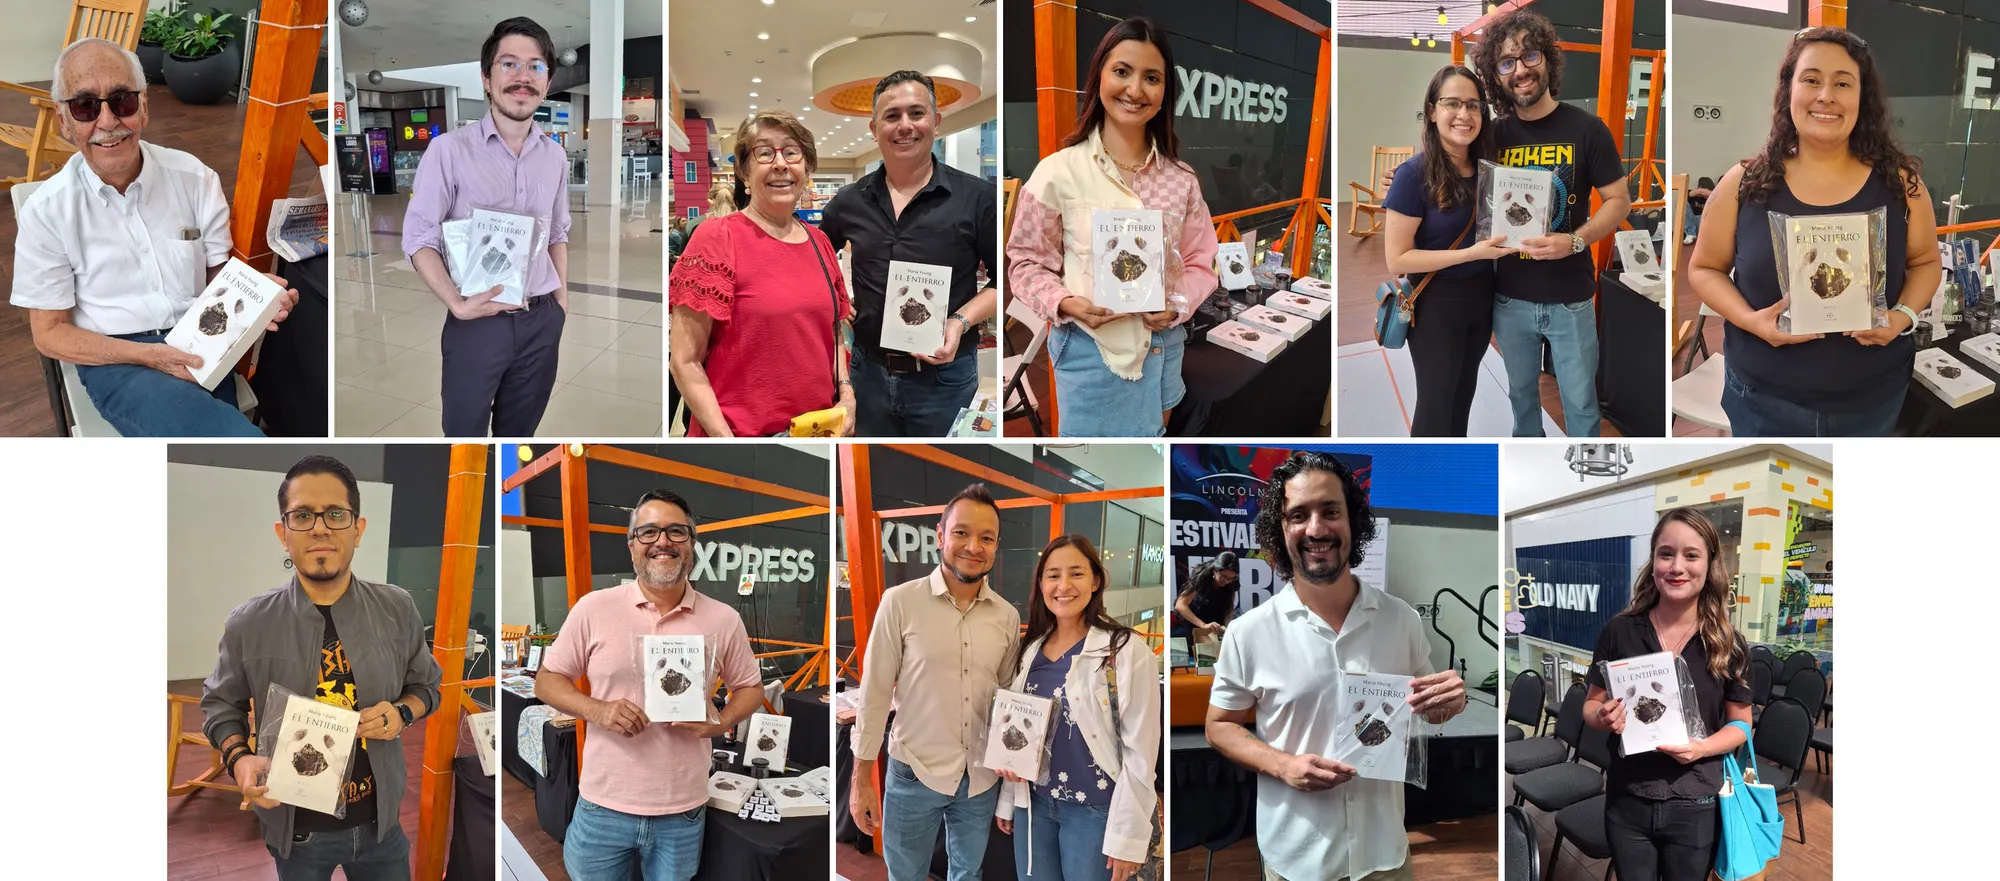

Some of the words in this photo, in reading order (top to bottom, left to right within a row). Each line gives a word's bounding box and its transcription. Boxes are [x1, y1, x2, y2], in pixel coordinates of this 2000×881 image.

[1964, 52, 2000, 110] E
[1174, 65, 1288, 124] XPRESS
[1510, 182, 1544, 191] ENTIERRO
[222, 271, 230, 281] EL
[230, 278, 264, 304] ENTIERRO
[907, 276, 944, 286] ENTIERRO
[1202, 484, 1265, 497] LINCOLN
[1220, 507, 1248, 516] PRESENTA
[689, 540, 815, 583] XPRESS
[1528, 582, 1555, 607] OLD
[1556, 583, 1600, 612] NAVY
[1630, 668, 1670, 681] ENTIERRO
[1348, 686, 1358, 694] EL
[1362, 688, 1406, 699] ENTIERRO
[292, 714, 302, 722] EL
[306, 717, 349, 734] ENTIERRO
